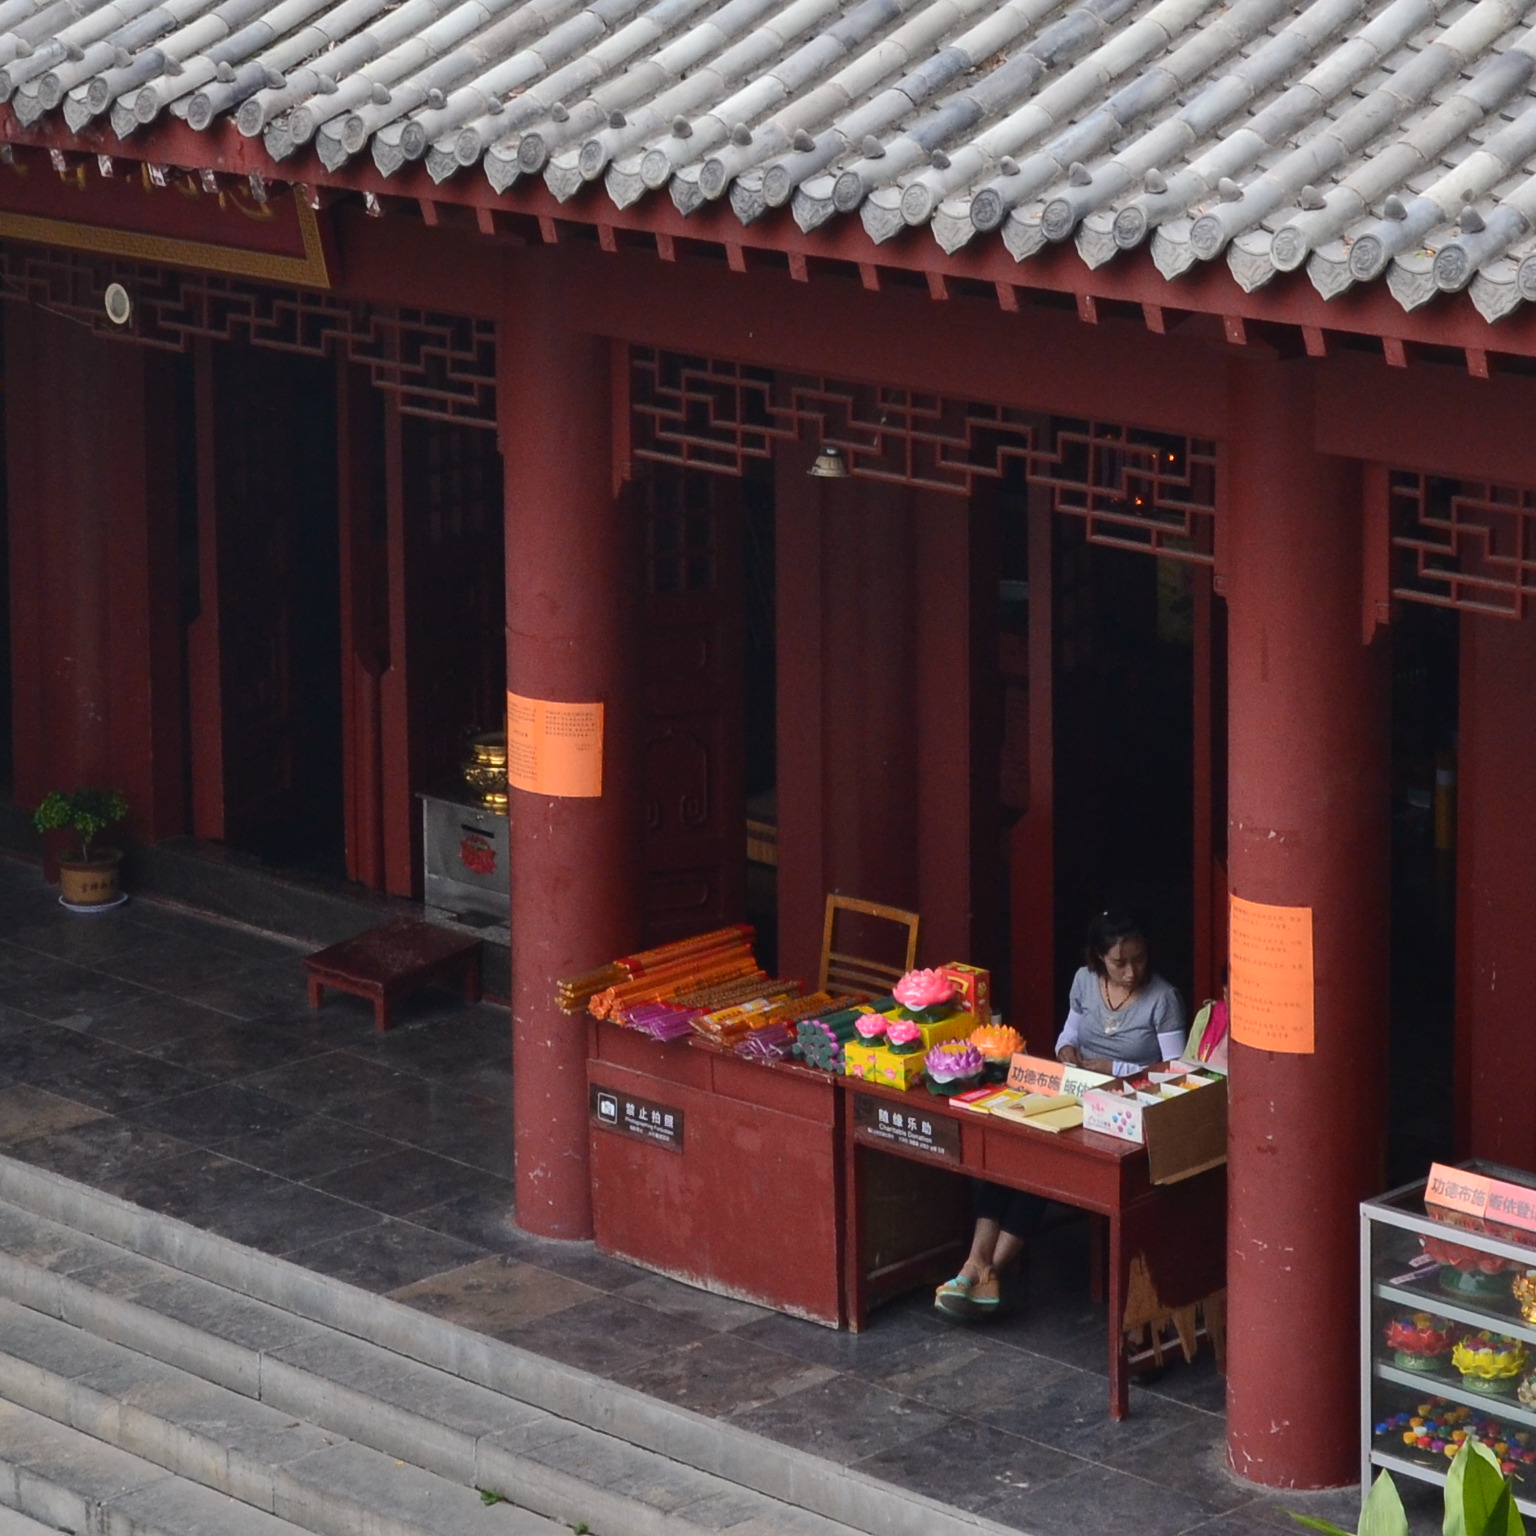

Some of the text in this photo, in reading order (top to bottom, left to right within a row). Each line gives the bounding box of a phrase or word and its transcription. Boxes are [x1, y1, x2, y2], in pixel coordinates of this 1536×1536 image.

[1011, 1065, 1093, 1097] 功德布施 皈依
[1431, 1176, 1487, 1207] 功德布施
